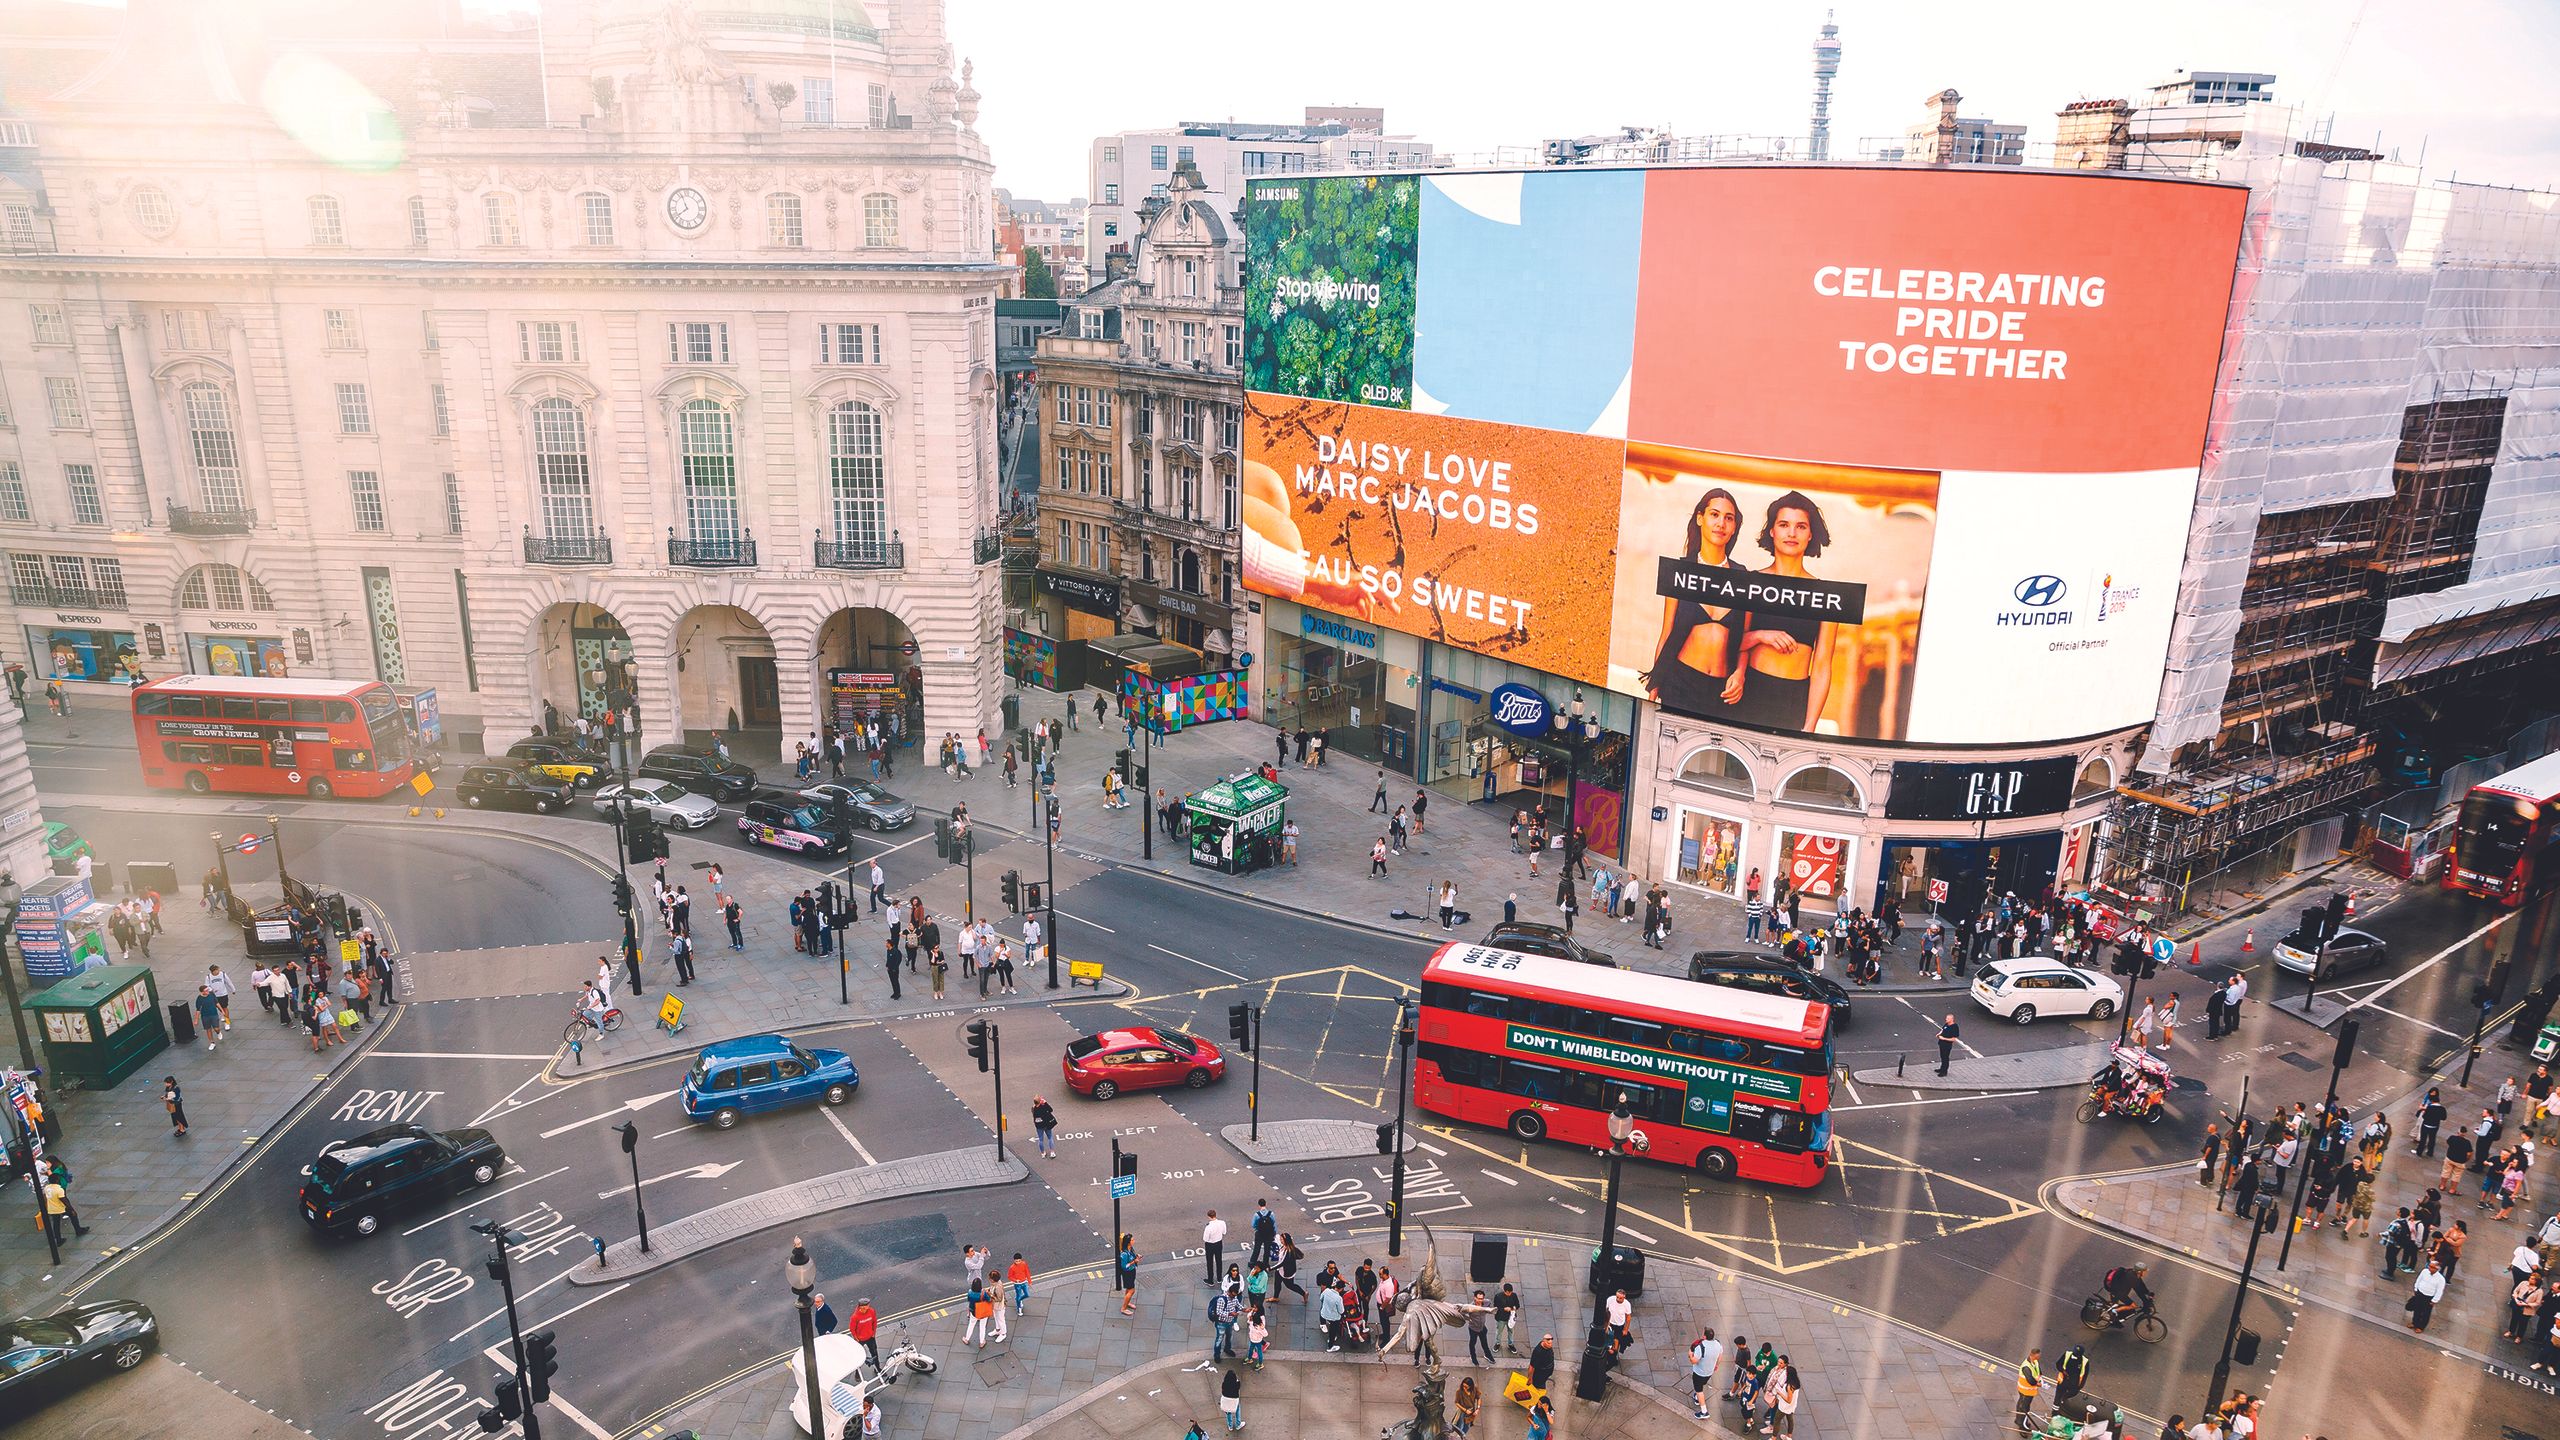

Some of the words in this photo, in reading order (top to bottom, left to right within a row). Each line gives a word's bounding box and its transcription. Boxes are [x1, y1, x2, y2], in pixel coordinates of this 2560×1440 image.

[1255, 187, 1299, 201] SAMSUNG
[1277, 277, 1311, 304] Stop
[1311, 277, 1380, 308] viewing
[1813, 266, 2106, 308] CELEBRATING
[1896, 307, 2027, 342] PRIDE
[1839, 341, 2068, 380] TOGETHER
[1361, 384, 1388, 402] QLED
[1390, 387, 1404, 403] 8K
[1319, 434, 1412, 474] DAISY
[1423, 450, 1512, 494] LOVE
[1296, 464, 1381, 504] MARC
[1392, 483, 1539, 535] JACOBS
[1058, 578, 1091, 592] VITTORIO
[1299, 548, 1351, 587] EAU
[1360, 563, 1402, 599] SO
[1411, 577, 1532, 632] SWEET
[1674, 570, 1843, 612] NET-A-PORTER
[2111, 587, 2140, 602] FRANCE
[1158, 594, 1181, 612] JEWEL
[1180, 601, 1197, 615] BAR
[2109, 602, 2125, 613] 2019
[56, 613, 102, 624] NESPRESSO
[210, 619, 258, 631] NESPRESSO
[1997, 611, 2073, 626] HYUNDAI
[1315, 618, 1376, 649] BARCLAYS
[2049, 641, 2080, 651] Official
[2081, 639, 2109, 649] Partner
[1495, 691, 1542, 725] Boots
[193, 729, 224, 738] CROWN
[224, 730, 260, 739] JEWELS
[1966, 771, 2023, 814] GAP
[2487, 823, 2499, 831] 14
[1192, 848, 1218, 865] WICKED
[62, 881, 83, 898] THEATRE
[64, 889, 84, 905] TICKETS
[973, 1006, 1006, 1015] LOOK
[1513, 1031, 1558, 1050] DON'T
[1562, 1040, 1653, 1068] WIMBLEDON
[1657, 1058, 1729, 1082] WITHOUT
[1731, 1072, 1748, 1085] IT
[330, 1088, 445, 1122] RGNT
[1055, 1130, 1094, 1141] LOOK
[1114, 1125, 1159, 1137] LEFT
[1161, 1169, 1206, 1180] LOOK
[1301, 1178, 1385, 1224] BUS
[1372, 1158, 1473, 1216] LANE
[1171, 1248, 1206, 1260] LOO
[2484, 1364, 2555, 1395] RIGHT
[363, 1369, 467, 1432] NO
